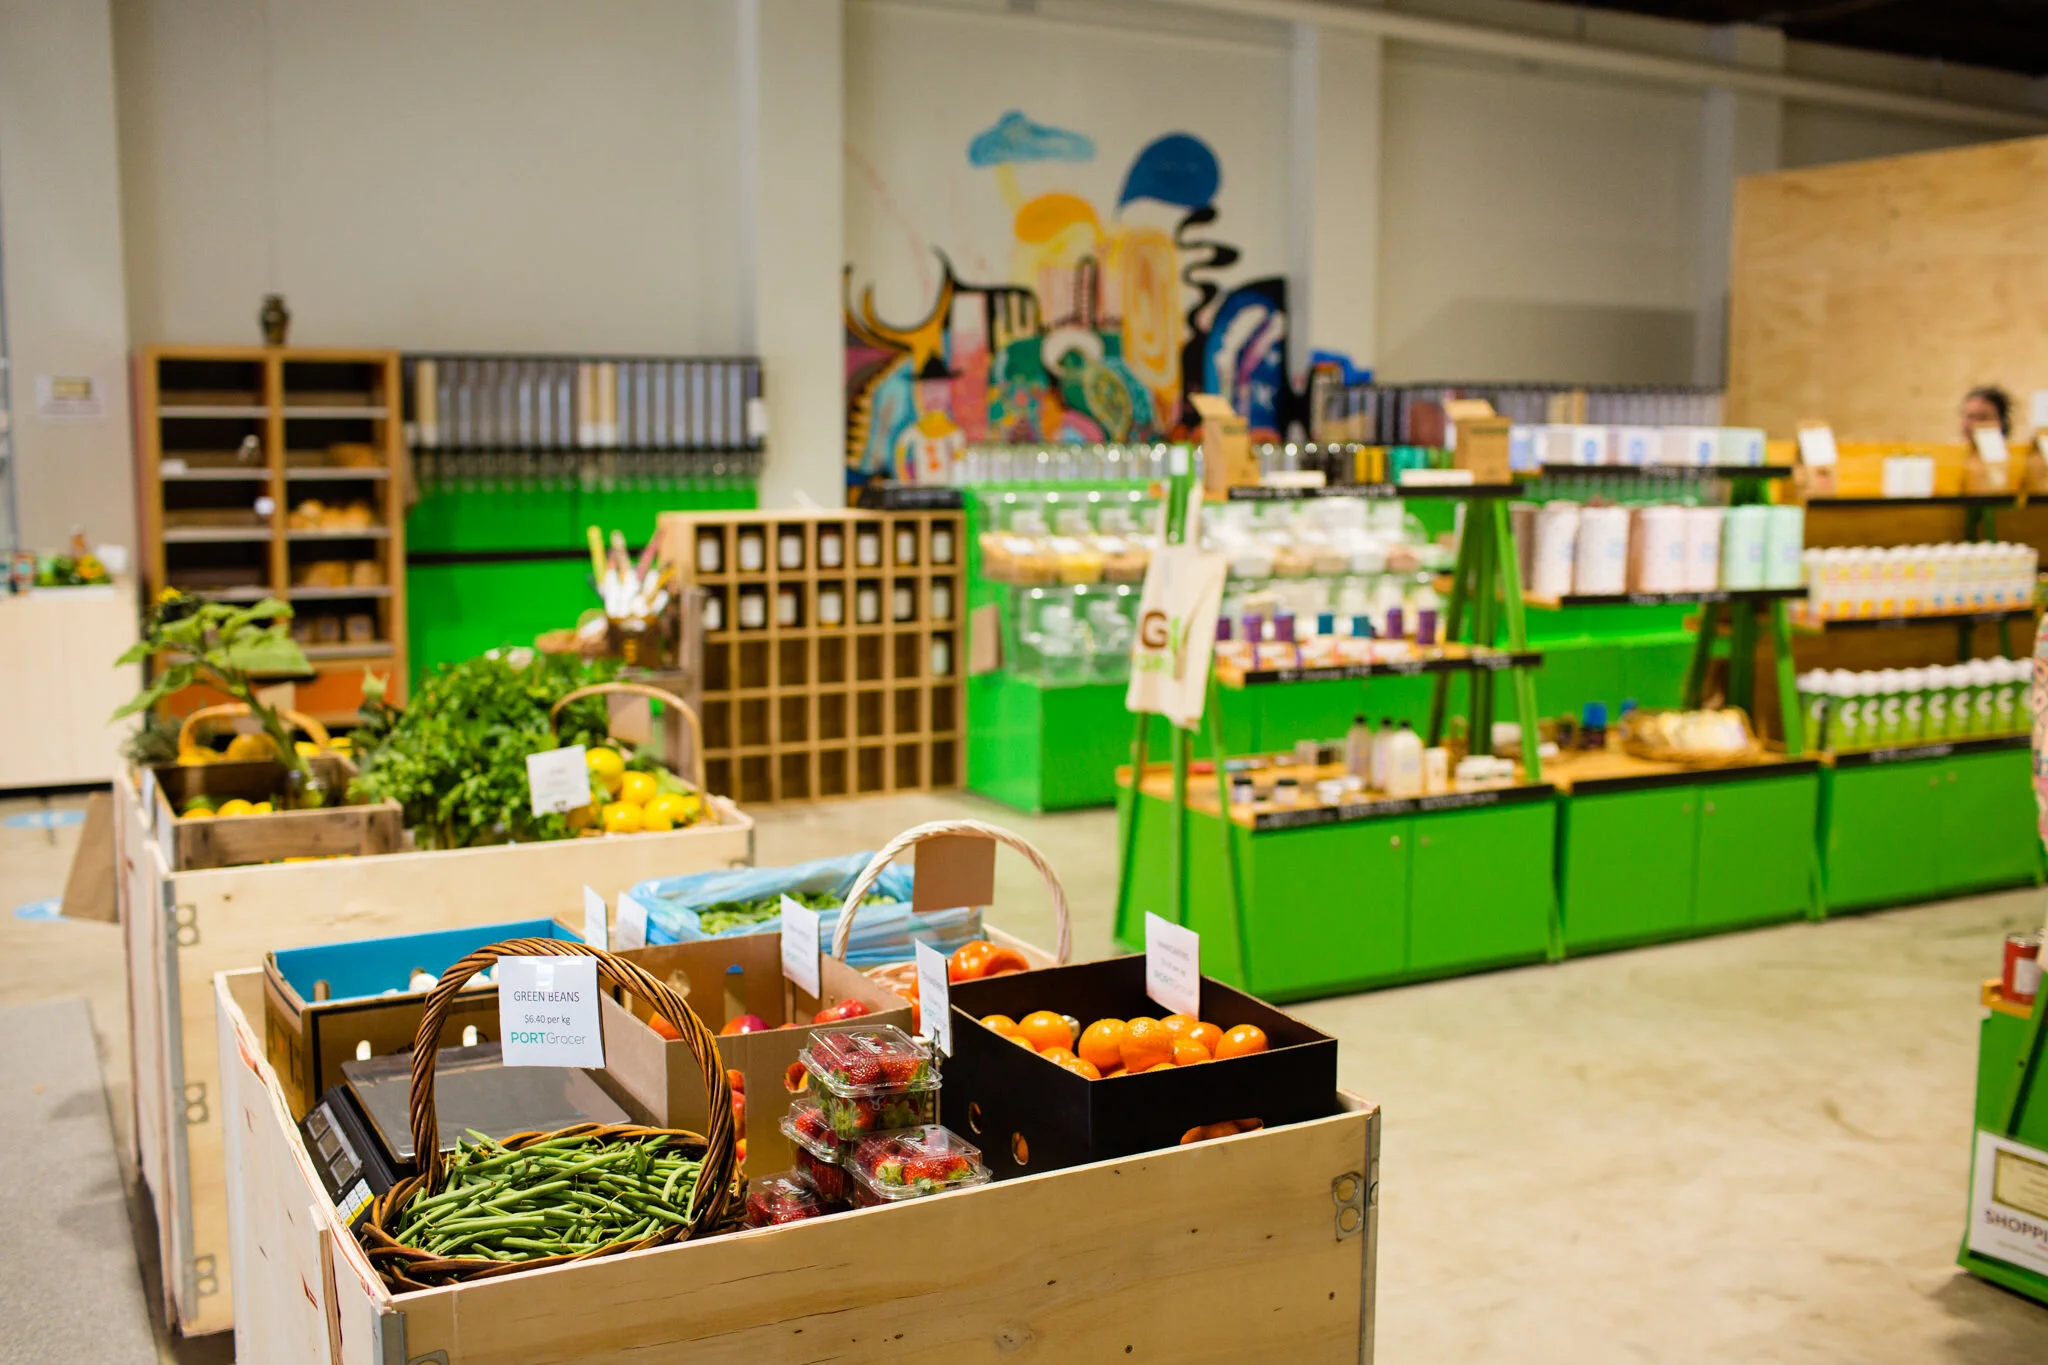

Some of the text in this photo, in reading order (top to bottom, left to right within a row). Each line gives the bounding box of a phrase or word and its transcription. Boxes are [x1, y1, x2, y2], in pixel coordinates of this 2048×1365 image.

[513, 990, 580, 1003] GREEN BEANS
[524, 1014, 571, 1026] $6.40 per kg
